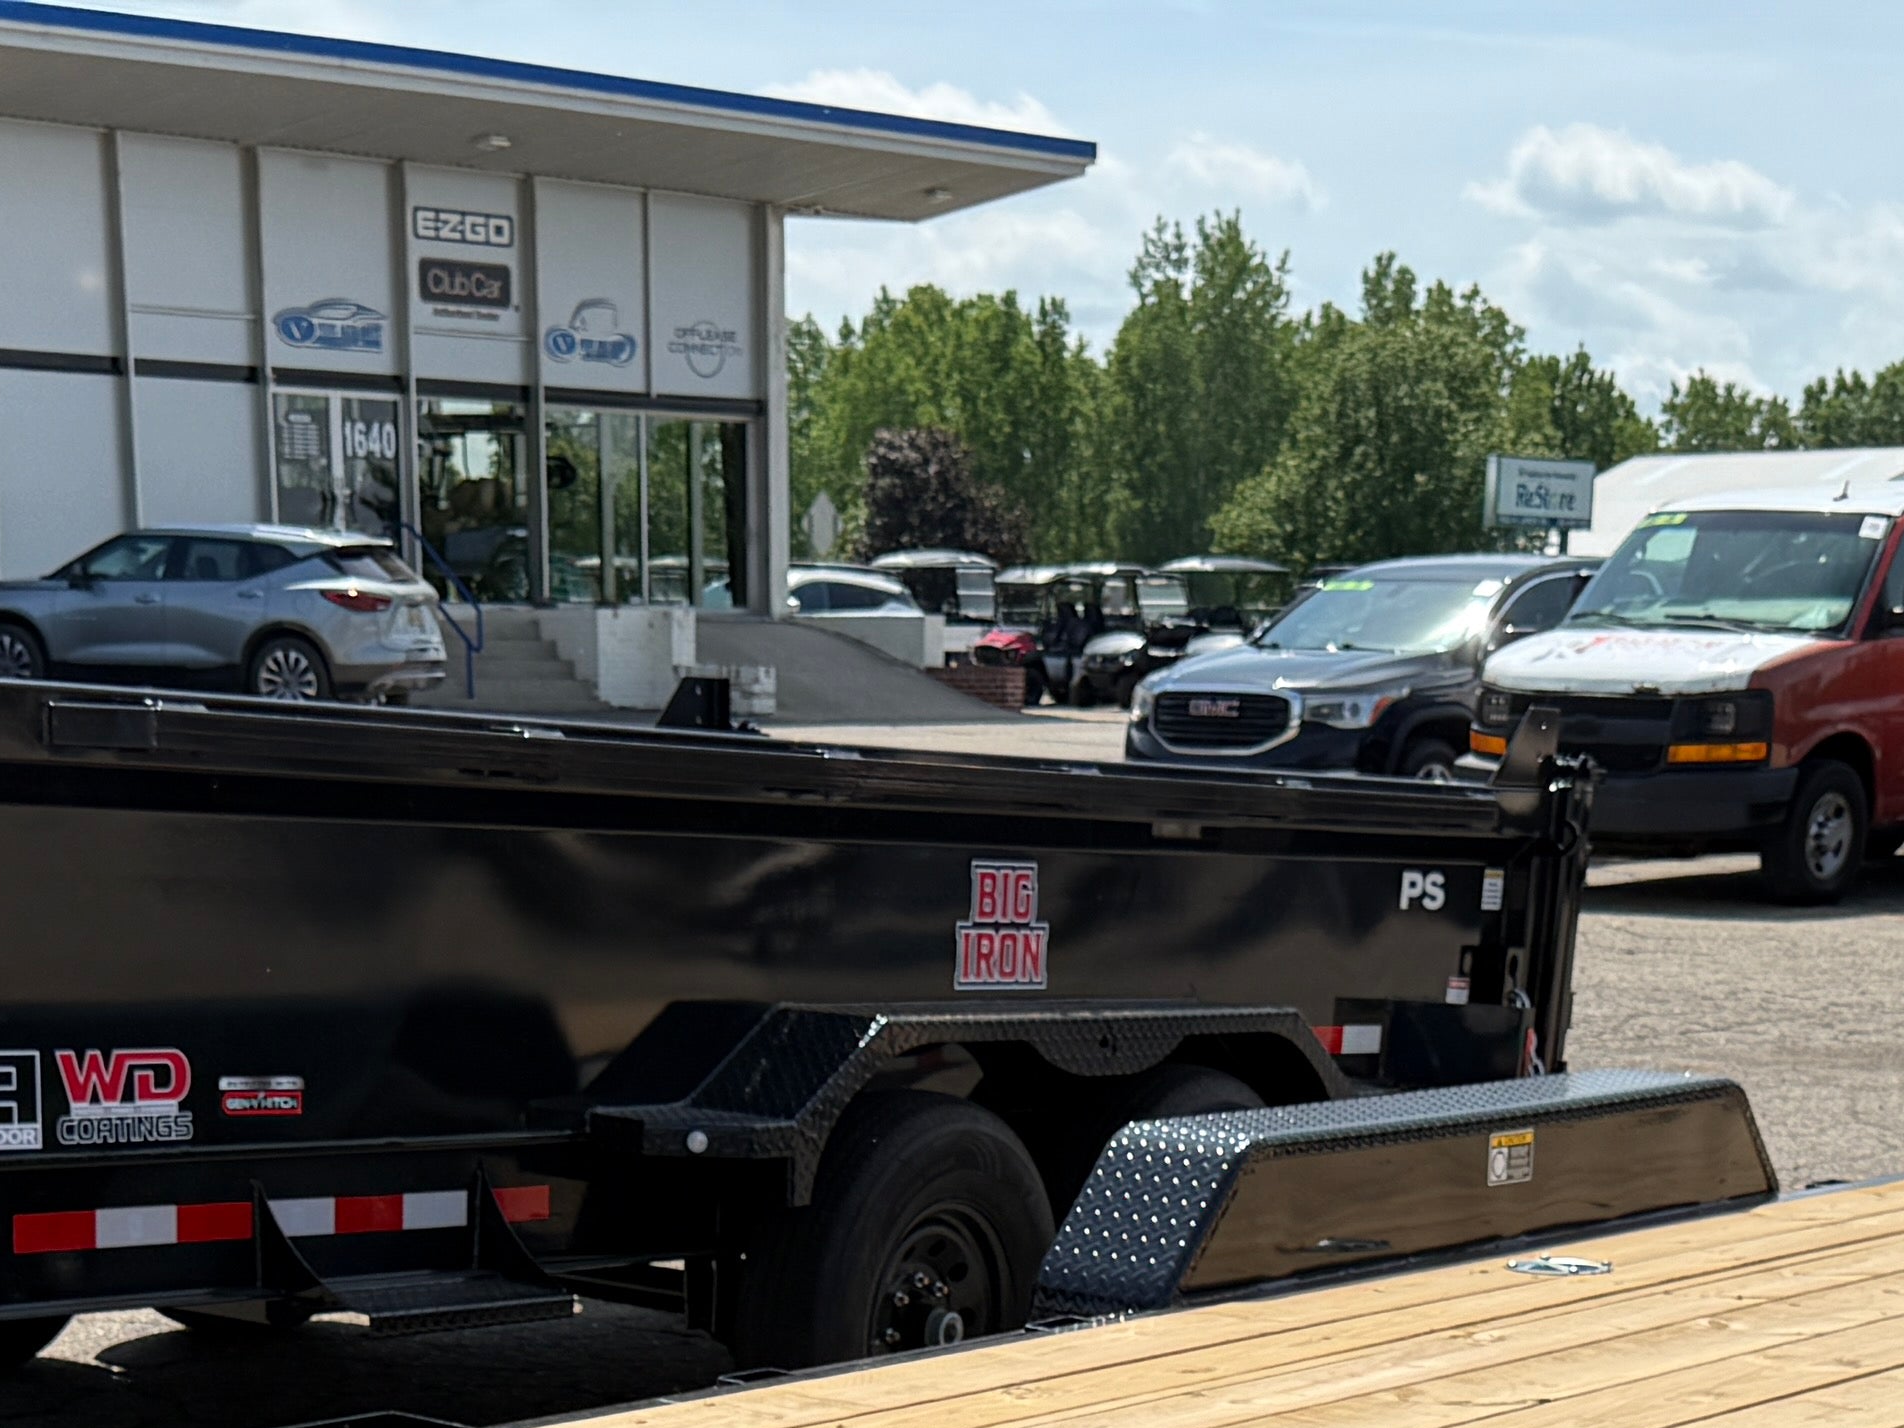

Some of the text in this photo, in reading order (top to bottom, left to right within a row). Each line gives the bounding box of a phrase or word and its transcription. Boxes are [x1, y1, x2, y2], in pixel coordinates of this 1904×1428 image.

[344, 421, 396, 459] 1640
[976, 869, 1034, 922] BIG
[1399, 870, 1446, 911] PS
[960, 930, 1043, 982] IRON
[54, 1048, 192, 1105] WD
[56, 1110, 195, 1145] COATINGS
